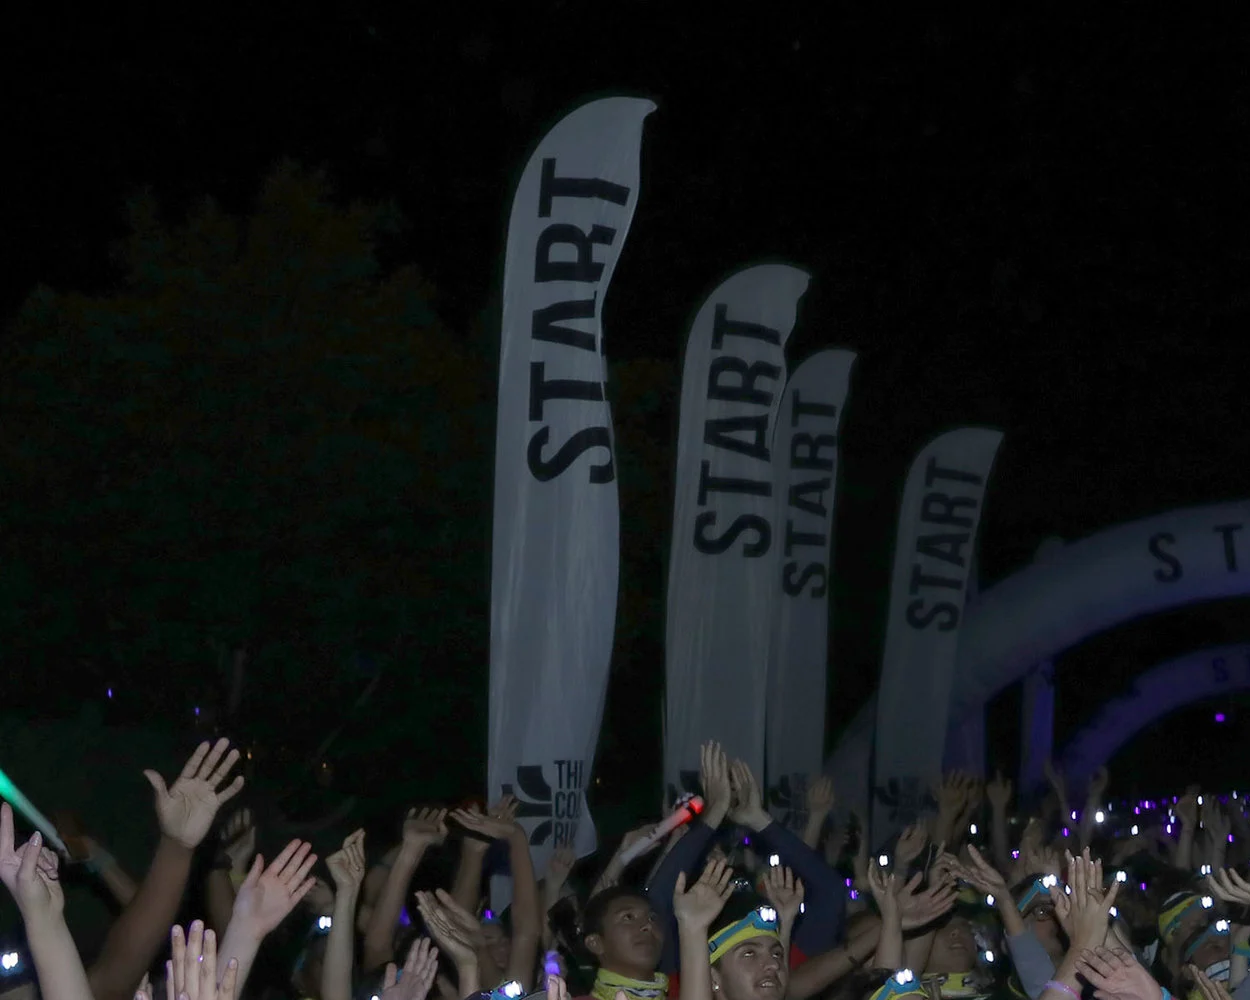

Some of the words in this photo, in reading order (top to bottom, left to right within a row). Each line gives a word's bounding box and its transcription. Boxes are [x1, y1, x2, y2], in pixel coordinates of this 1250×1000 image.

[527, 157, 631, 484] START
[693, 303, 783, 558] START
[783, 388, 837, 599] START
[904, 456, 984, 633] START
[554, 760, 584, 789] TH
